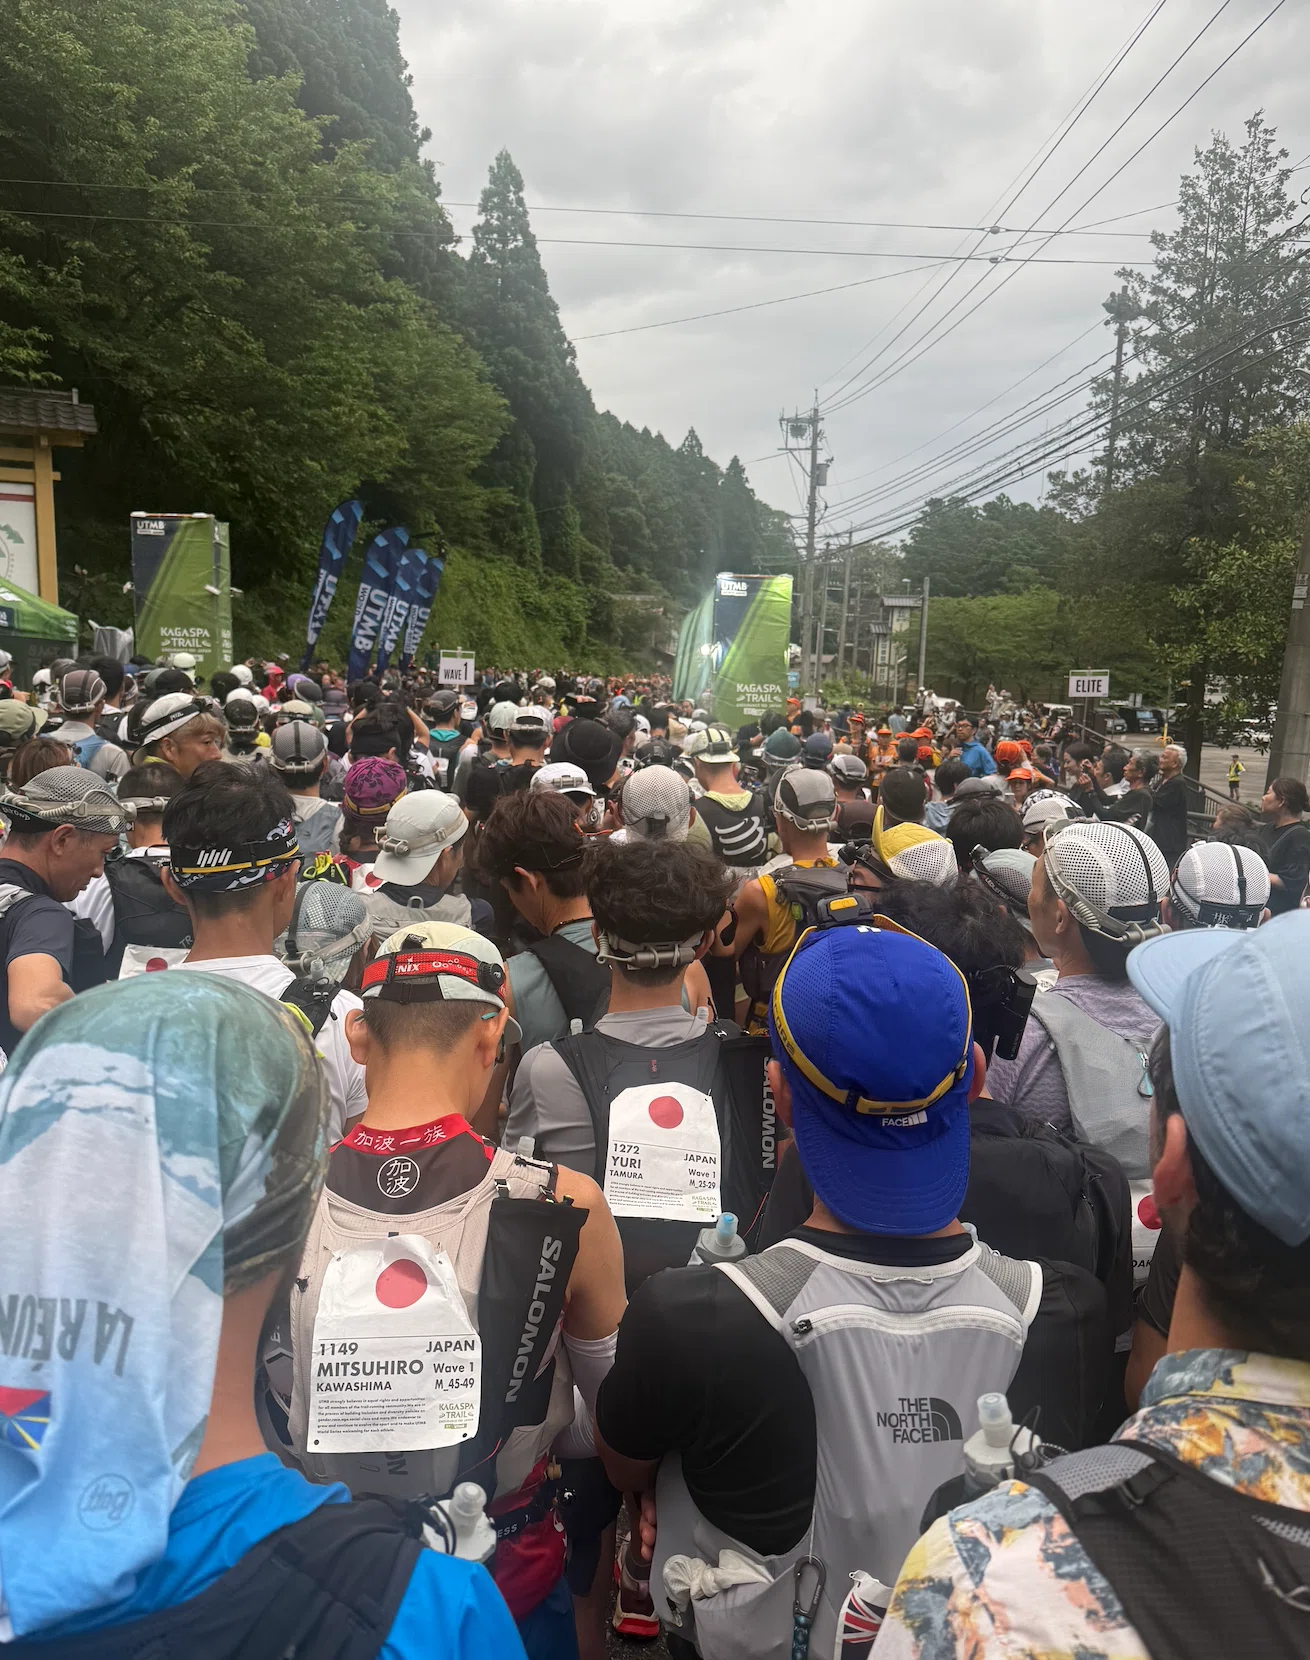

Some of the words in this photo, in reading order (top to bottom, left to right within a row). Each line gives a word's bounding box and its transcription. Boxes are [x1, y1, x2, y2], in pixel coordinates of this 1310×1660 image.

[136, 520, 165, 529] UTMB
[720, 580, 748, 590] UTMB
[354, 588, 388, 651] UTMB
[384, 600, 410, 652] UTMB
[160, 627, 210, 638] KAGASPA
[171, 638, 202, 648] TRAIL
[444, 668, 462, 680] WAVE
[464, 662, 468, 680] 1
[736, 683, 782, 693] KAGASPA
[1076, 680, 1102, 692] ELITE
[745, 694, 774, 702] TRAIL
[394, 960, 420, 974] NIX
[882, 1116, 908, 1127] FACE
[354, 1124, 446, 1152] 加波一族
[614, 1143, 640, 1155] 1272
[684, 1154, 716, 1164] JAPAN
[612, 1156, 641, 1169] YURI
[386, 1160, 412, 1194] 加波
[610, 1170, 643, 1180] TAMURA
[688, 1168, 710, 1178] Wave
[689, 1179, 716, 1189] M_25-29
[505, 1236, 562, 1402] SALOMON
[94, 1300, 134, 1378] LA
[320, 1342, 359, 1356] 1149
[426, 1340, 475, 1353] JAPAN
[317, 1359, 424, 1377] MITSUHIRO
[433, 1363, 465, 1373] Wave
[470, 1362, 474, 1372] 1
[316, 1381, 392, 1392] KAWASHIMA
[435, 1378, 474, 1392] M_45-49
[898, 1398, 929, 1412] THE
[877, 1412, 930, 1428] NORTH
[893, 1428, 932, 1443] FACE
